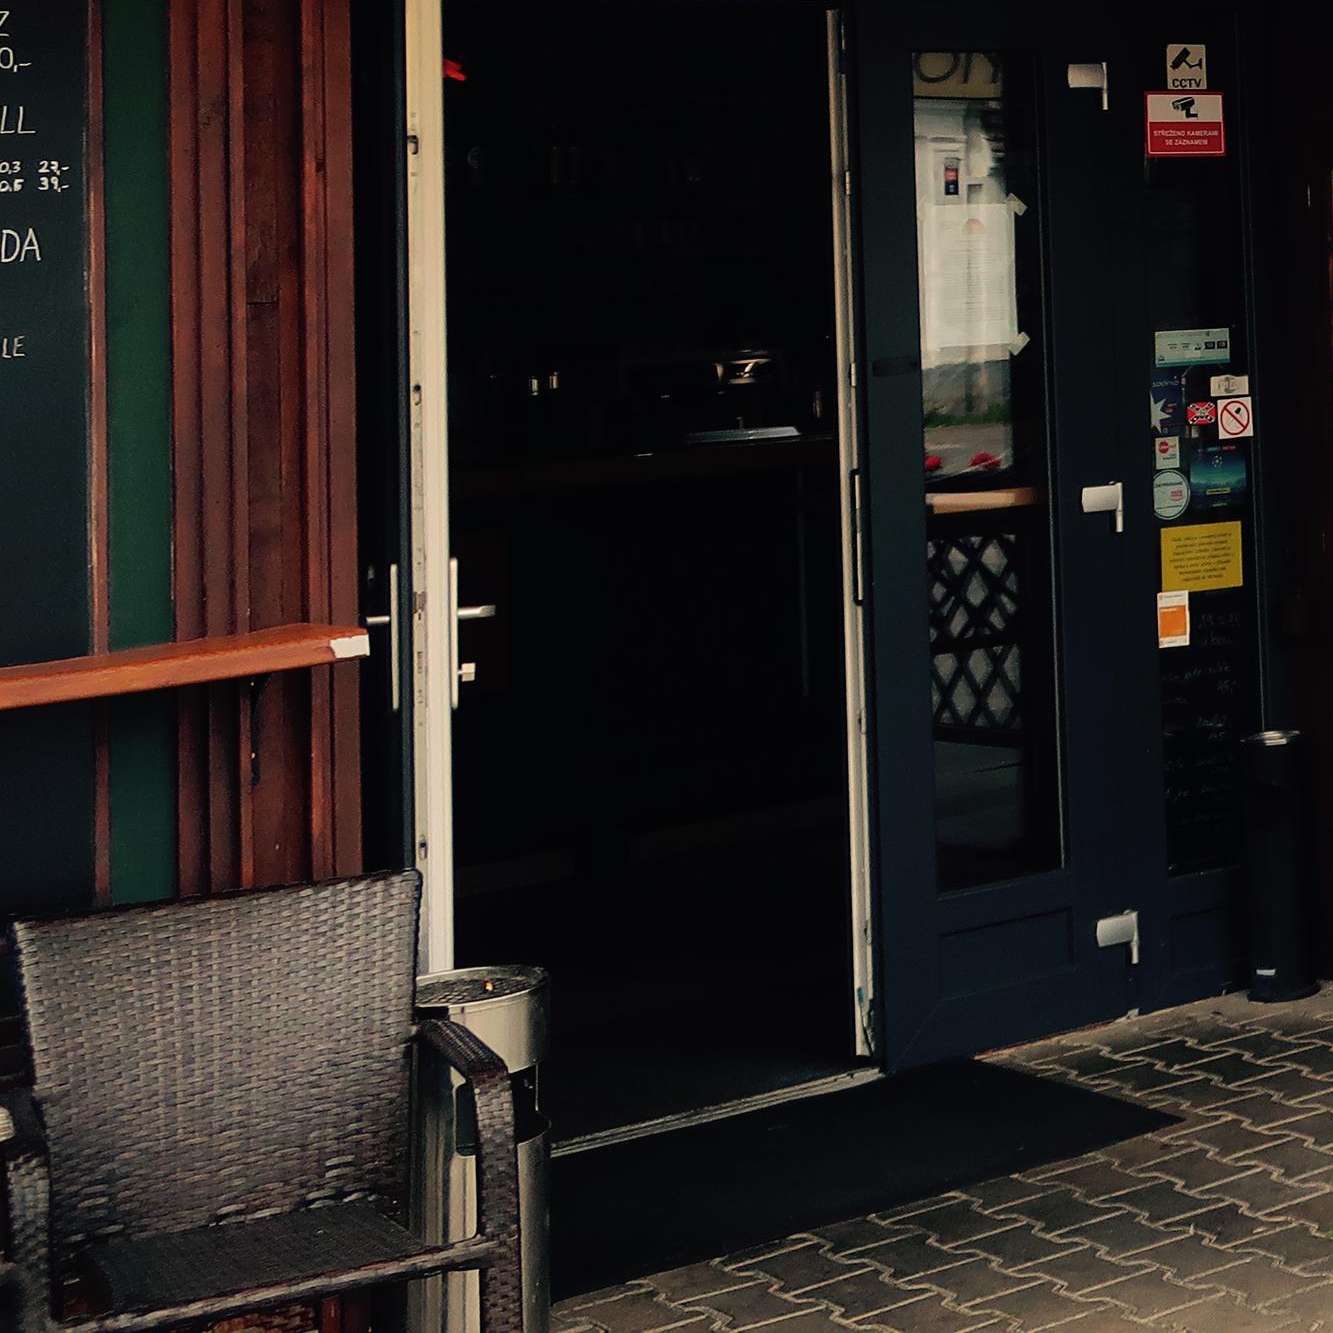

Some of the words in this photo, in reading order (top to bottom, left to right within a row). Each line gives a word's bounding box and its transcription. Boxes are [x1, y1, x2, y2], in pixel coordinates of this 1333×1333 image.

[1171, 78, 1202, 89] CCTV
[1186, 129, 1219, 137] KAMERAMI
[1, 227, 42, 263] DA
[2, 335, 27, 359] LE
